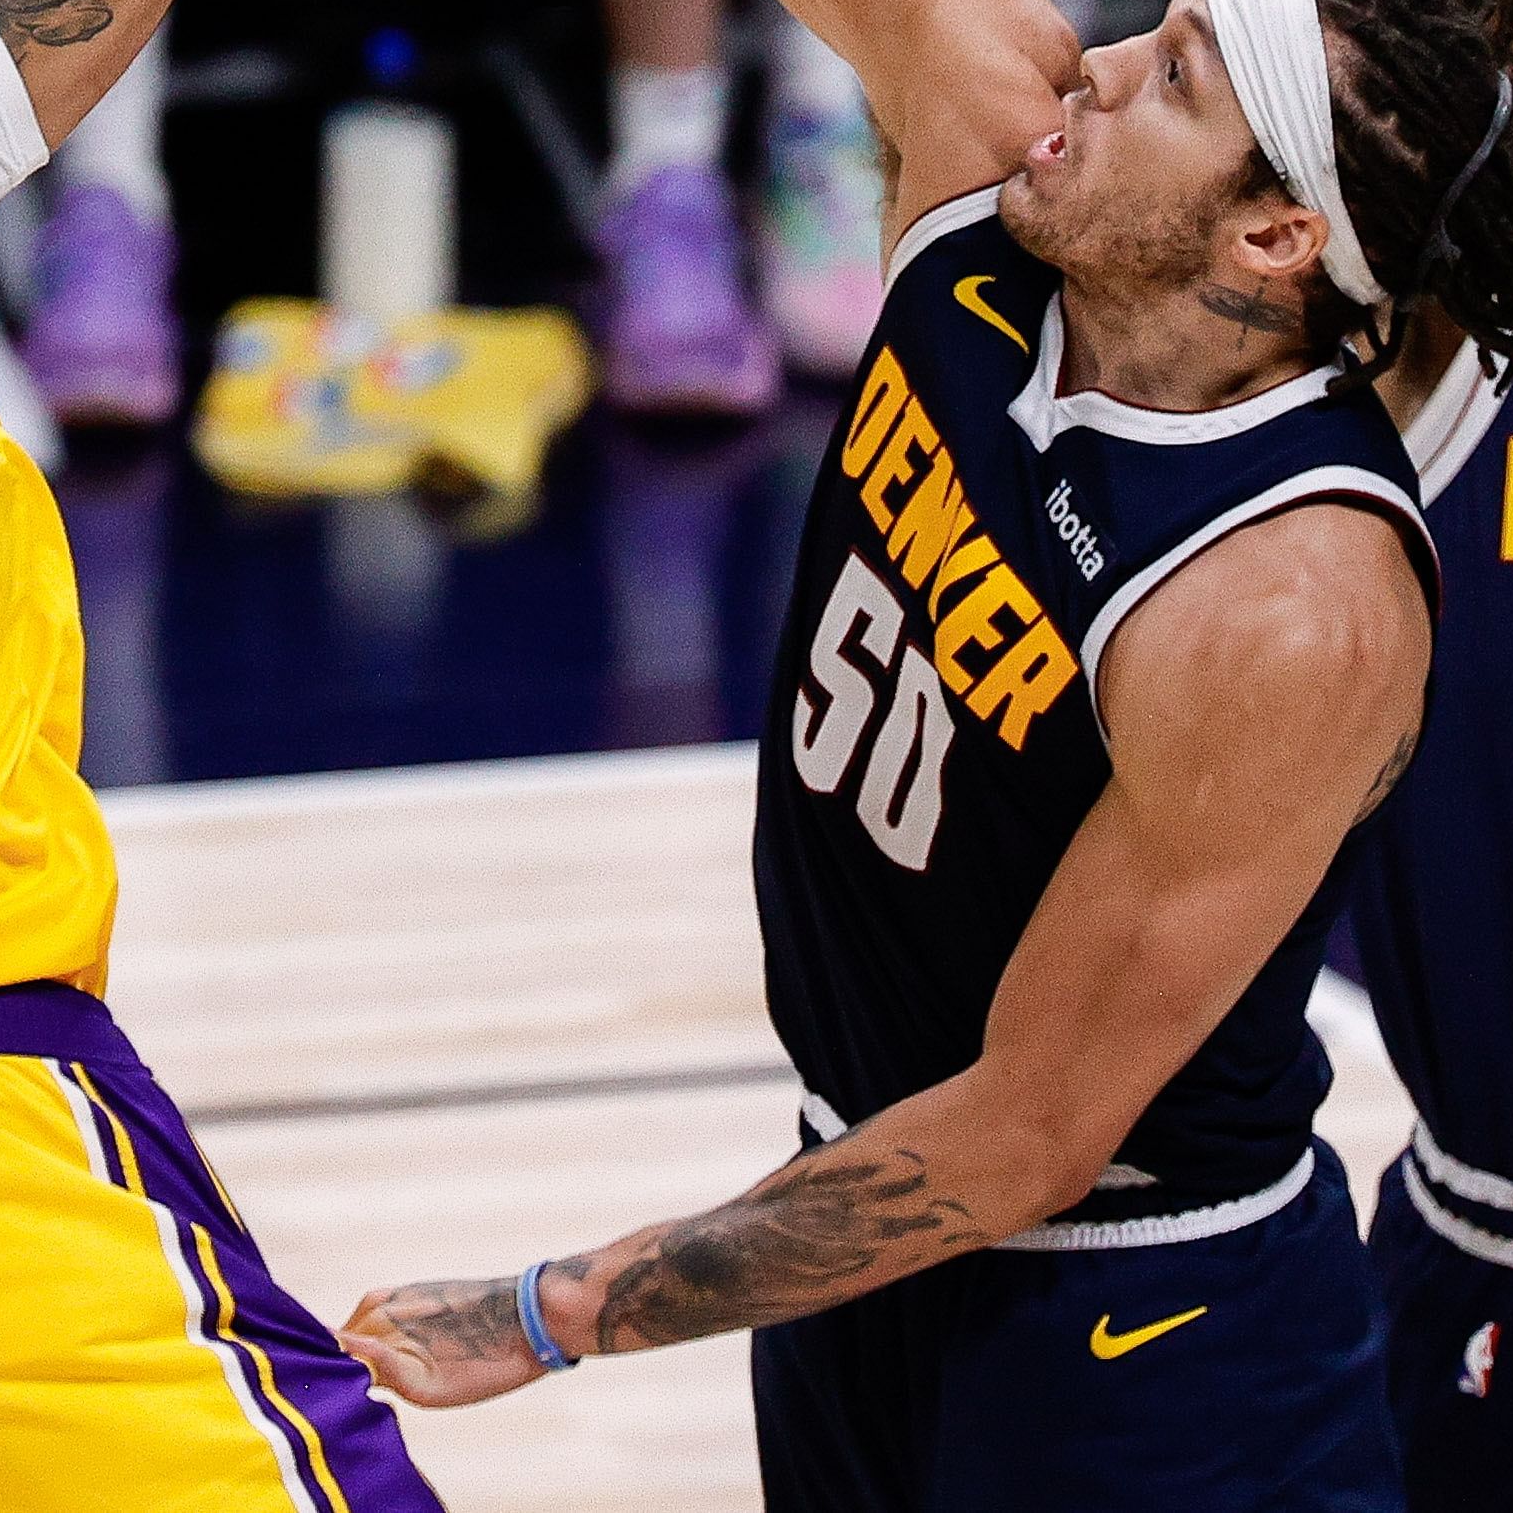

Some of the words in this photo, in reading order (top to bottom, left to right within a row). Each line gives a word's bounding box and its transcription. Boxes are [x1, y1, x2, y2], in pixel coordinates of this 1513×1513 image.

[841, 344, 1080, 753] DENVER
[1044, 477, 1105, 582] ibotta
[791, 549, 956, 873] 50
